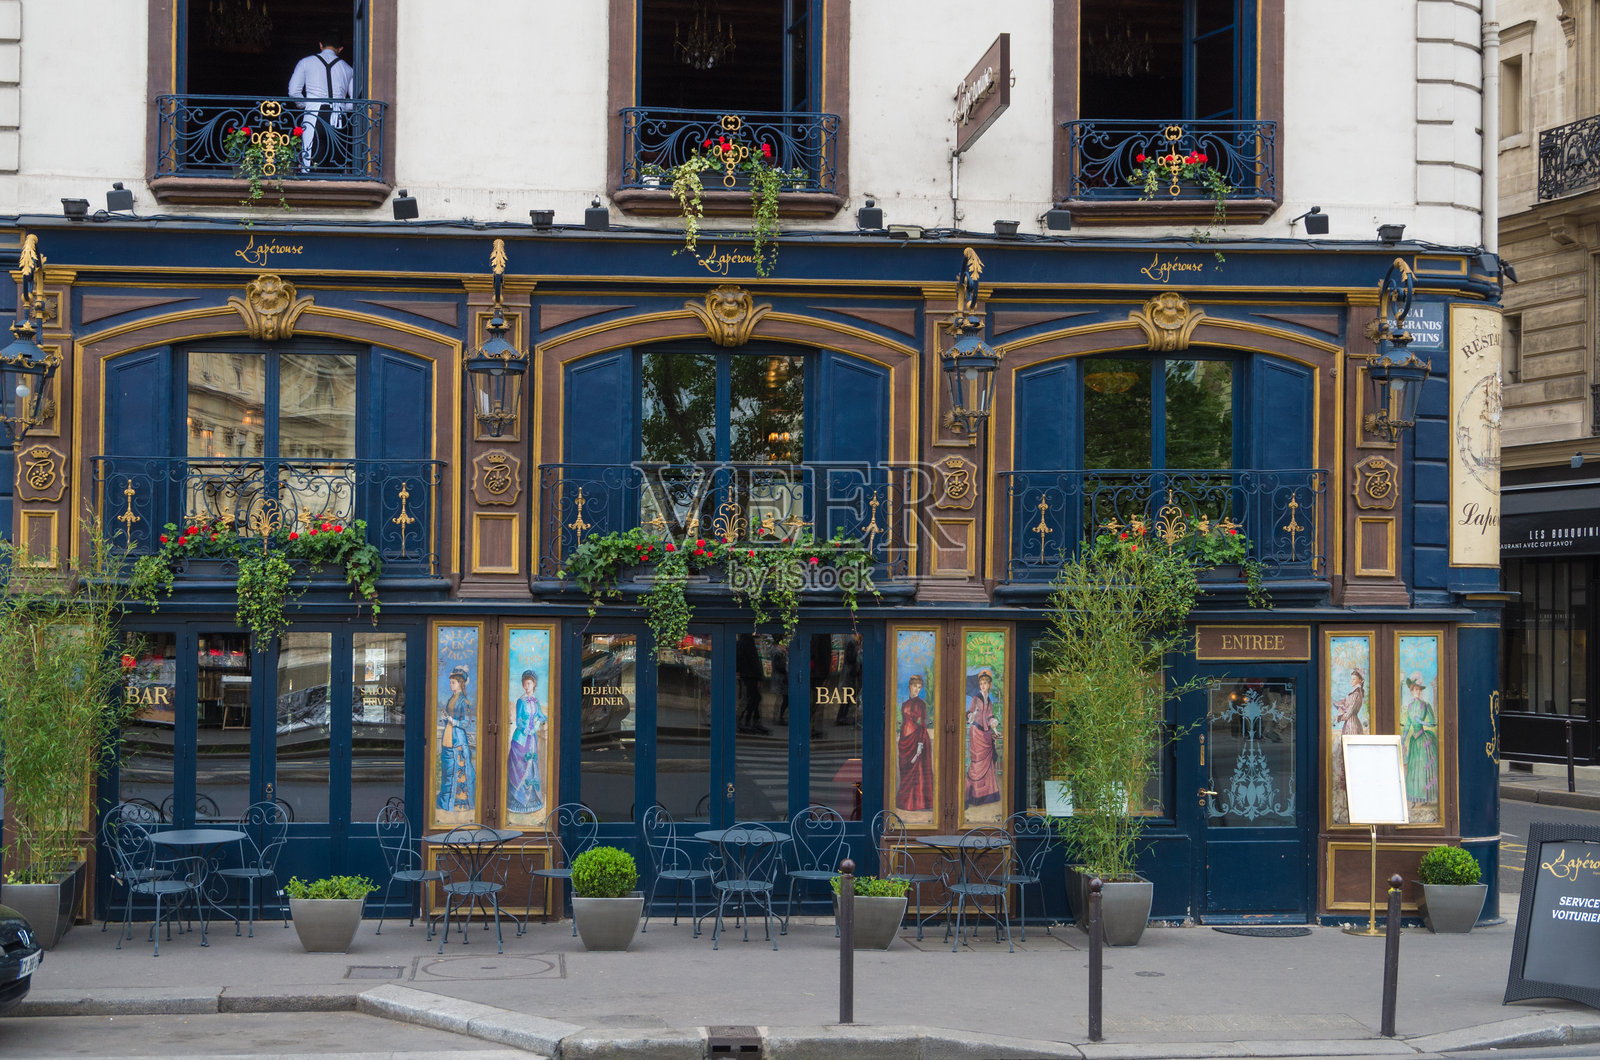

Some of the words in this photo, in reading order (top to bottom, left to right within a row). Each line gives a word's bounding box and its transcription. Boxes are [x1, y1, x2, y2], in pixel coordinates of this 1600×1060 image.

[234, 234, 304, 266] Lapérouse
[698, 244, 764, 276] Lapérous
[1140, 252, 1204, 283] Lapérouse
[1401, 320, 1442, 331] GRANDS
[1529, 529, 1545, 540] LES
[1523, 541, 1539, 549] AVEC
[1540, 540, 1552, 548] GUY
[1221, 634, 1285, 651] ENTREE
[125, 686, 170, 705] BAR
[360, 686, 397, 696] SALONS
[583, 686, 634, 696] DEJEUNER
[815, 686, 857, 705] BAR
[592, 697, 624, 706] DINER
[1559, 896, 1600, 909] SERVICE
